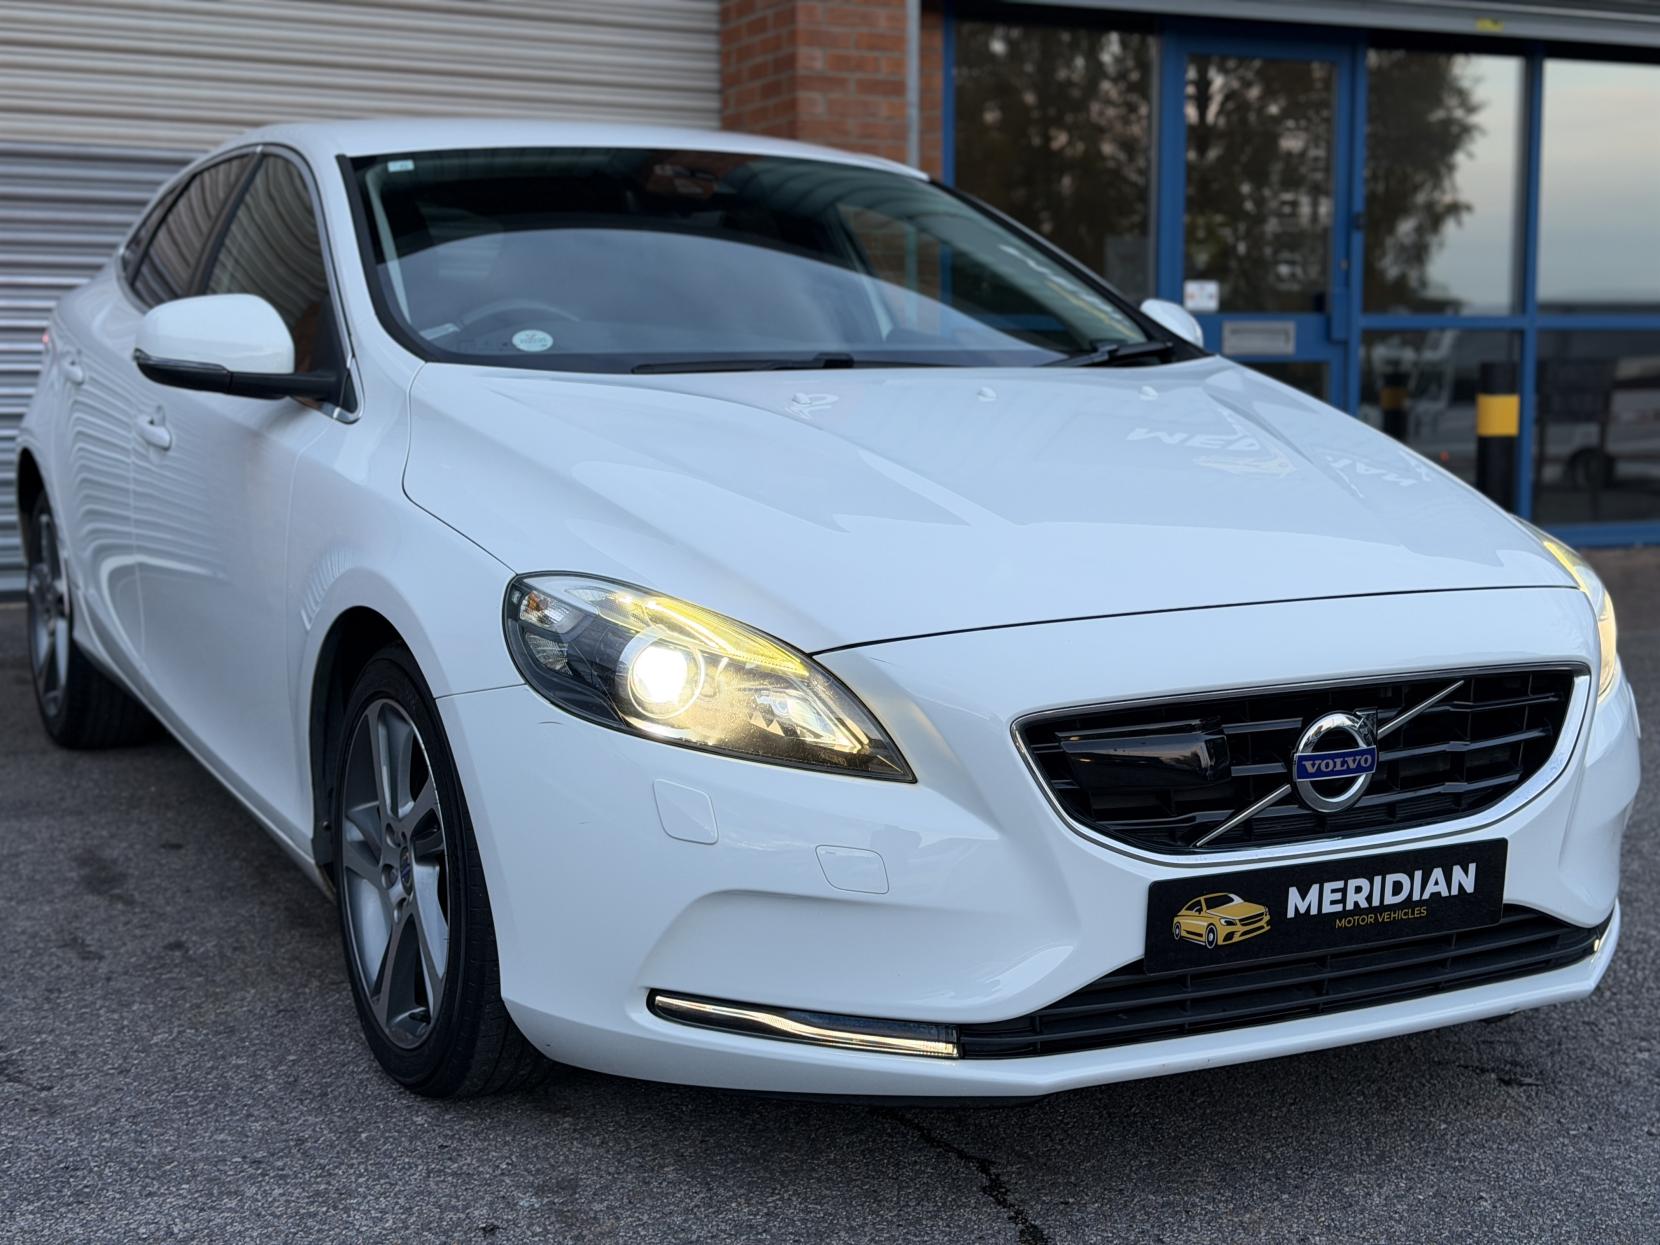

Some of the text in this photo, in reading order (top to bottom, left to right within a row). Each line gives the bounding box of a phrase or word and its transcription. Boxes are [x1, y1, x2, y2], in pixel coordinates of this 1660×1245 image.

[1302, 754, 1372, 774] VOLVO
[1286, 862, 1477, 919] MERIDIAN
[1335, 906, 1427, 929] MOTOR VEHICLES
